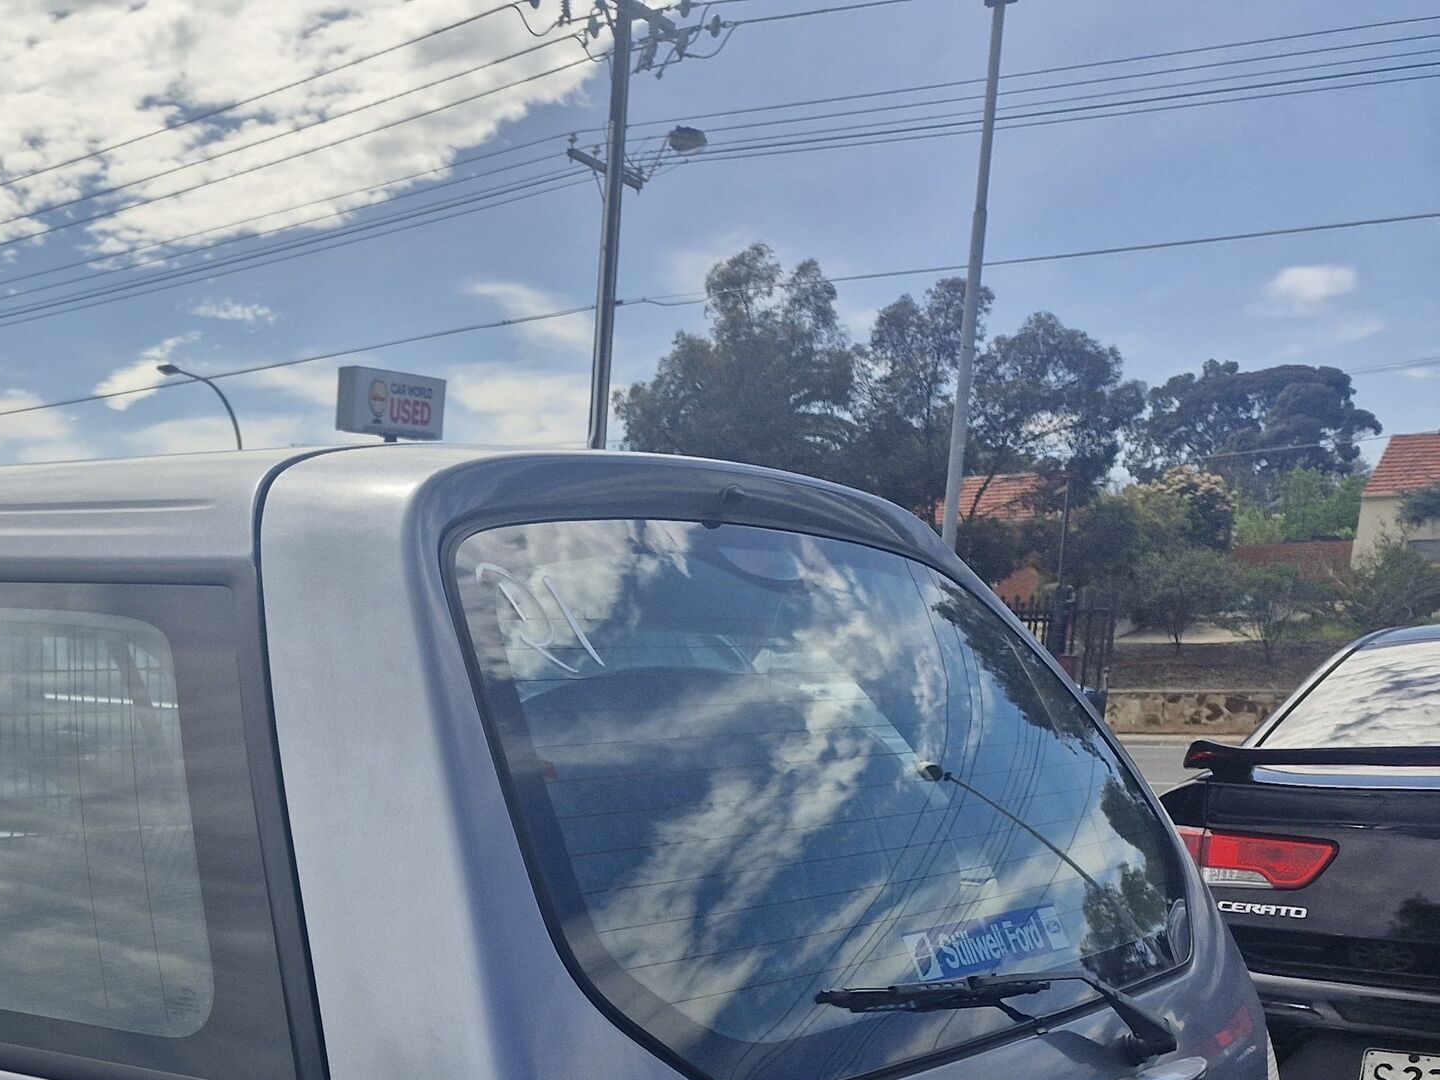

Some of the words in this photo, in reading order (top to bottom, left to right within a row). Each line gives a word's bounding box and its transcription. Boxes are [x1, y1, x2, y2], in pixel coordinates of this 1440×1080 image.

[390, 397, 433, 427] USED
[1218, 901, 1307, 918] CERATO
[939, 924, 1005, 969] Stillwell
[1002, 916, 1045, 954] Ford
